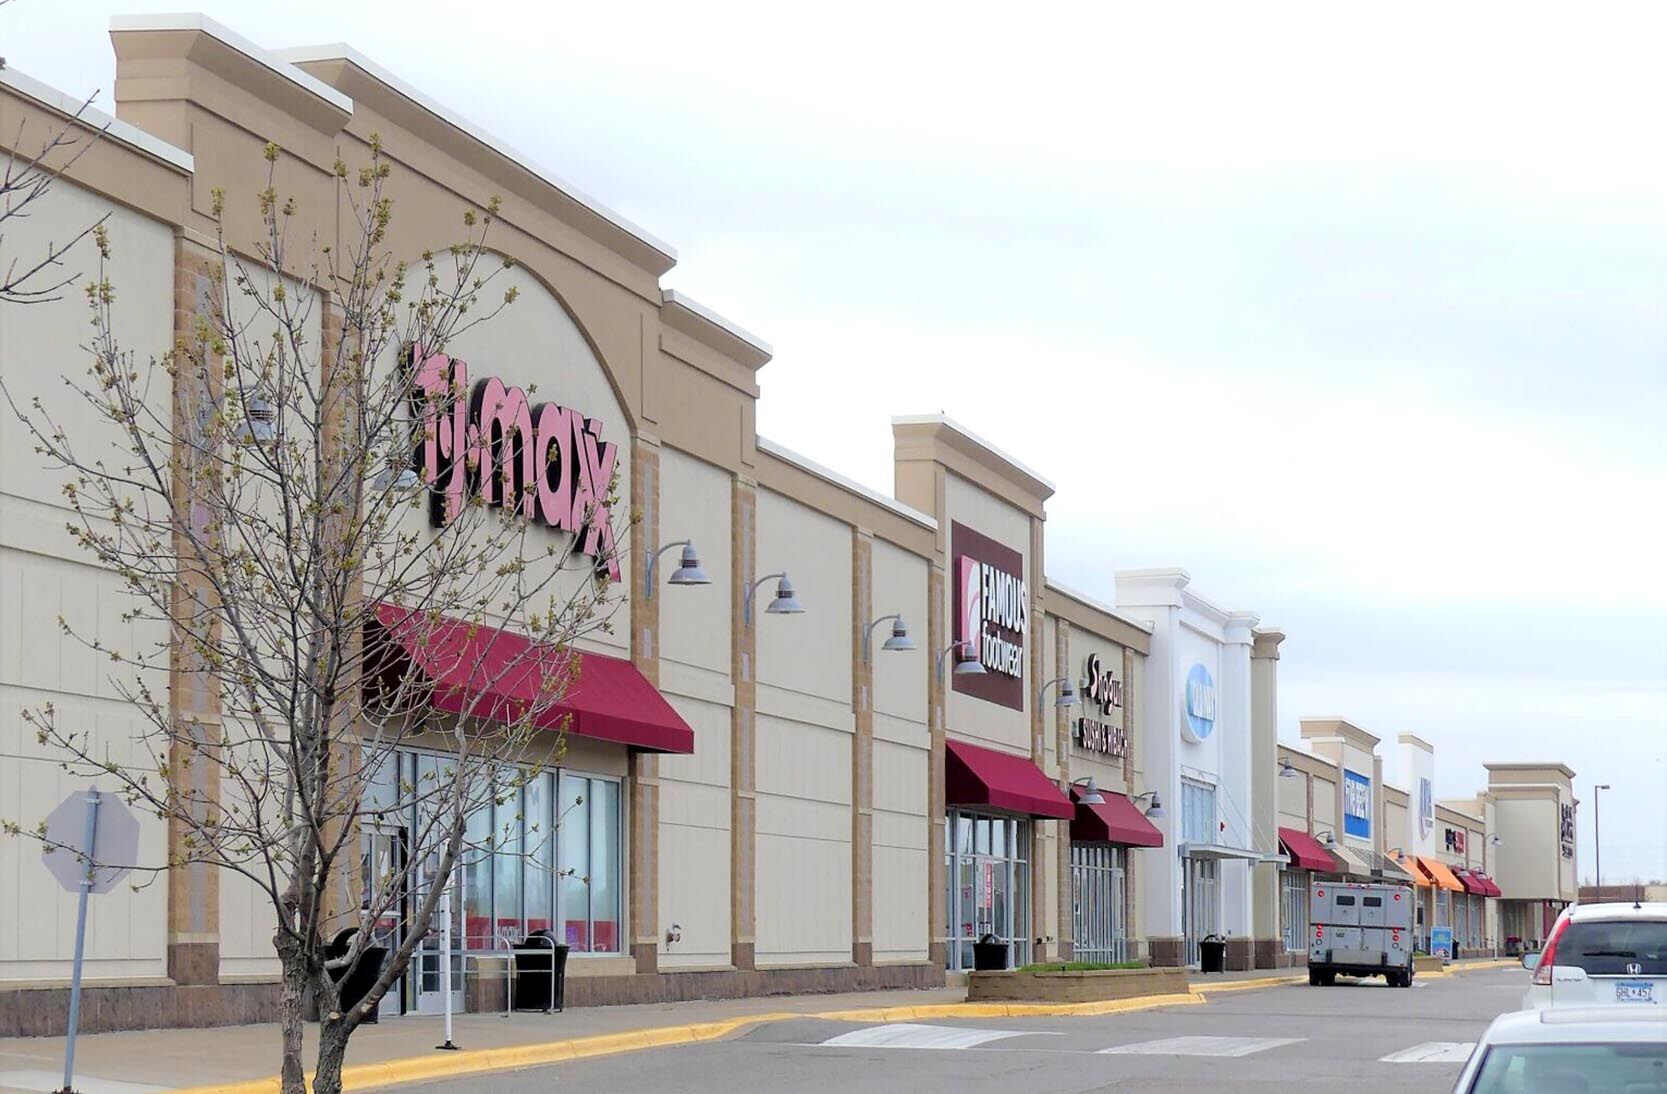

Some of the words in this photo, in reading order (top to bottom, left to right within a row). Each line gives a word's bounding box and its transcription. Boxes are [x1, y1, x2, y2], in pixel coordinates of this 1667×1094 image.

[981, 563, 1027, 634] FAMOUS
[982, 620, 1023, 678] footwear
[1087, 653, 1123, 714] Shogun
[1082, 718, 1101, 752] SUSHI
